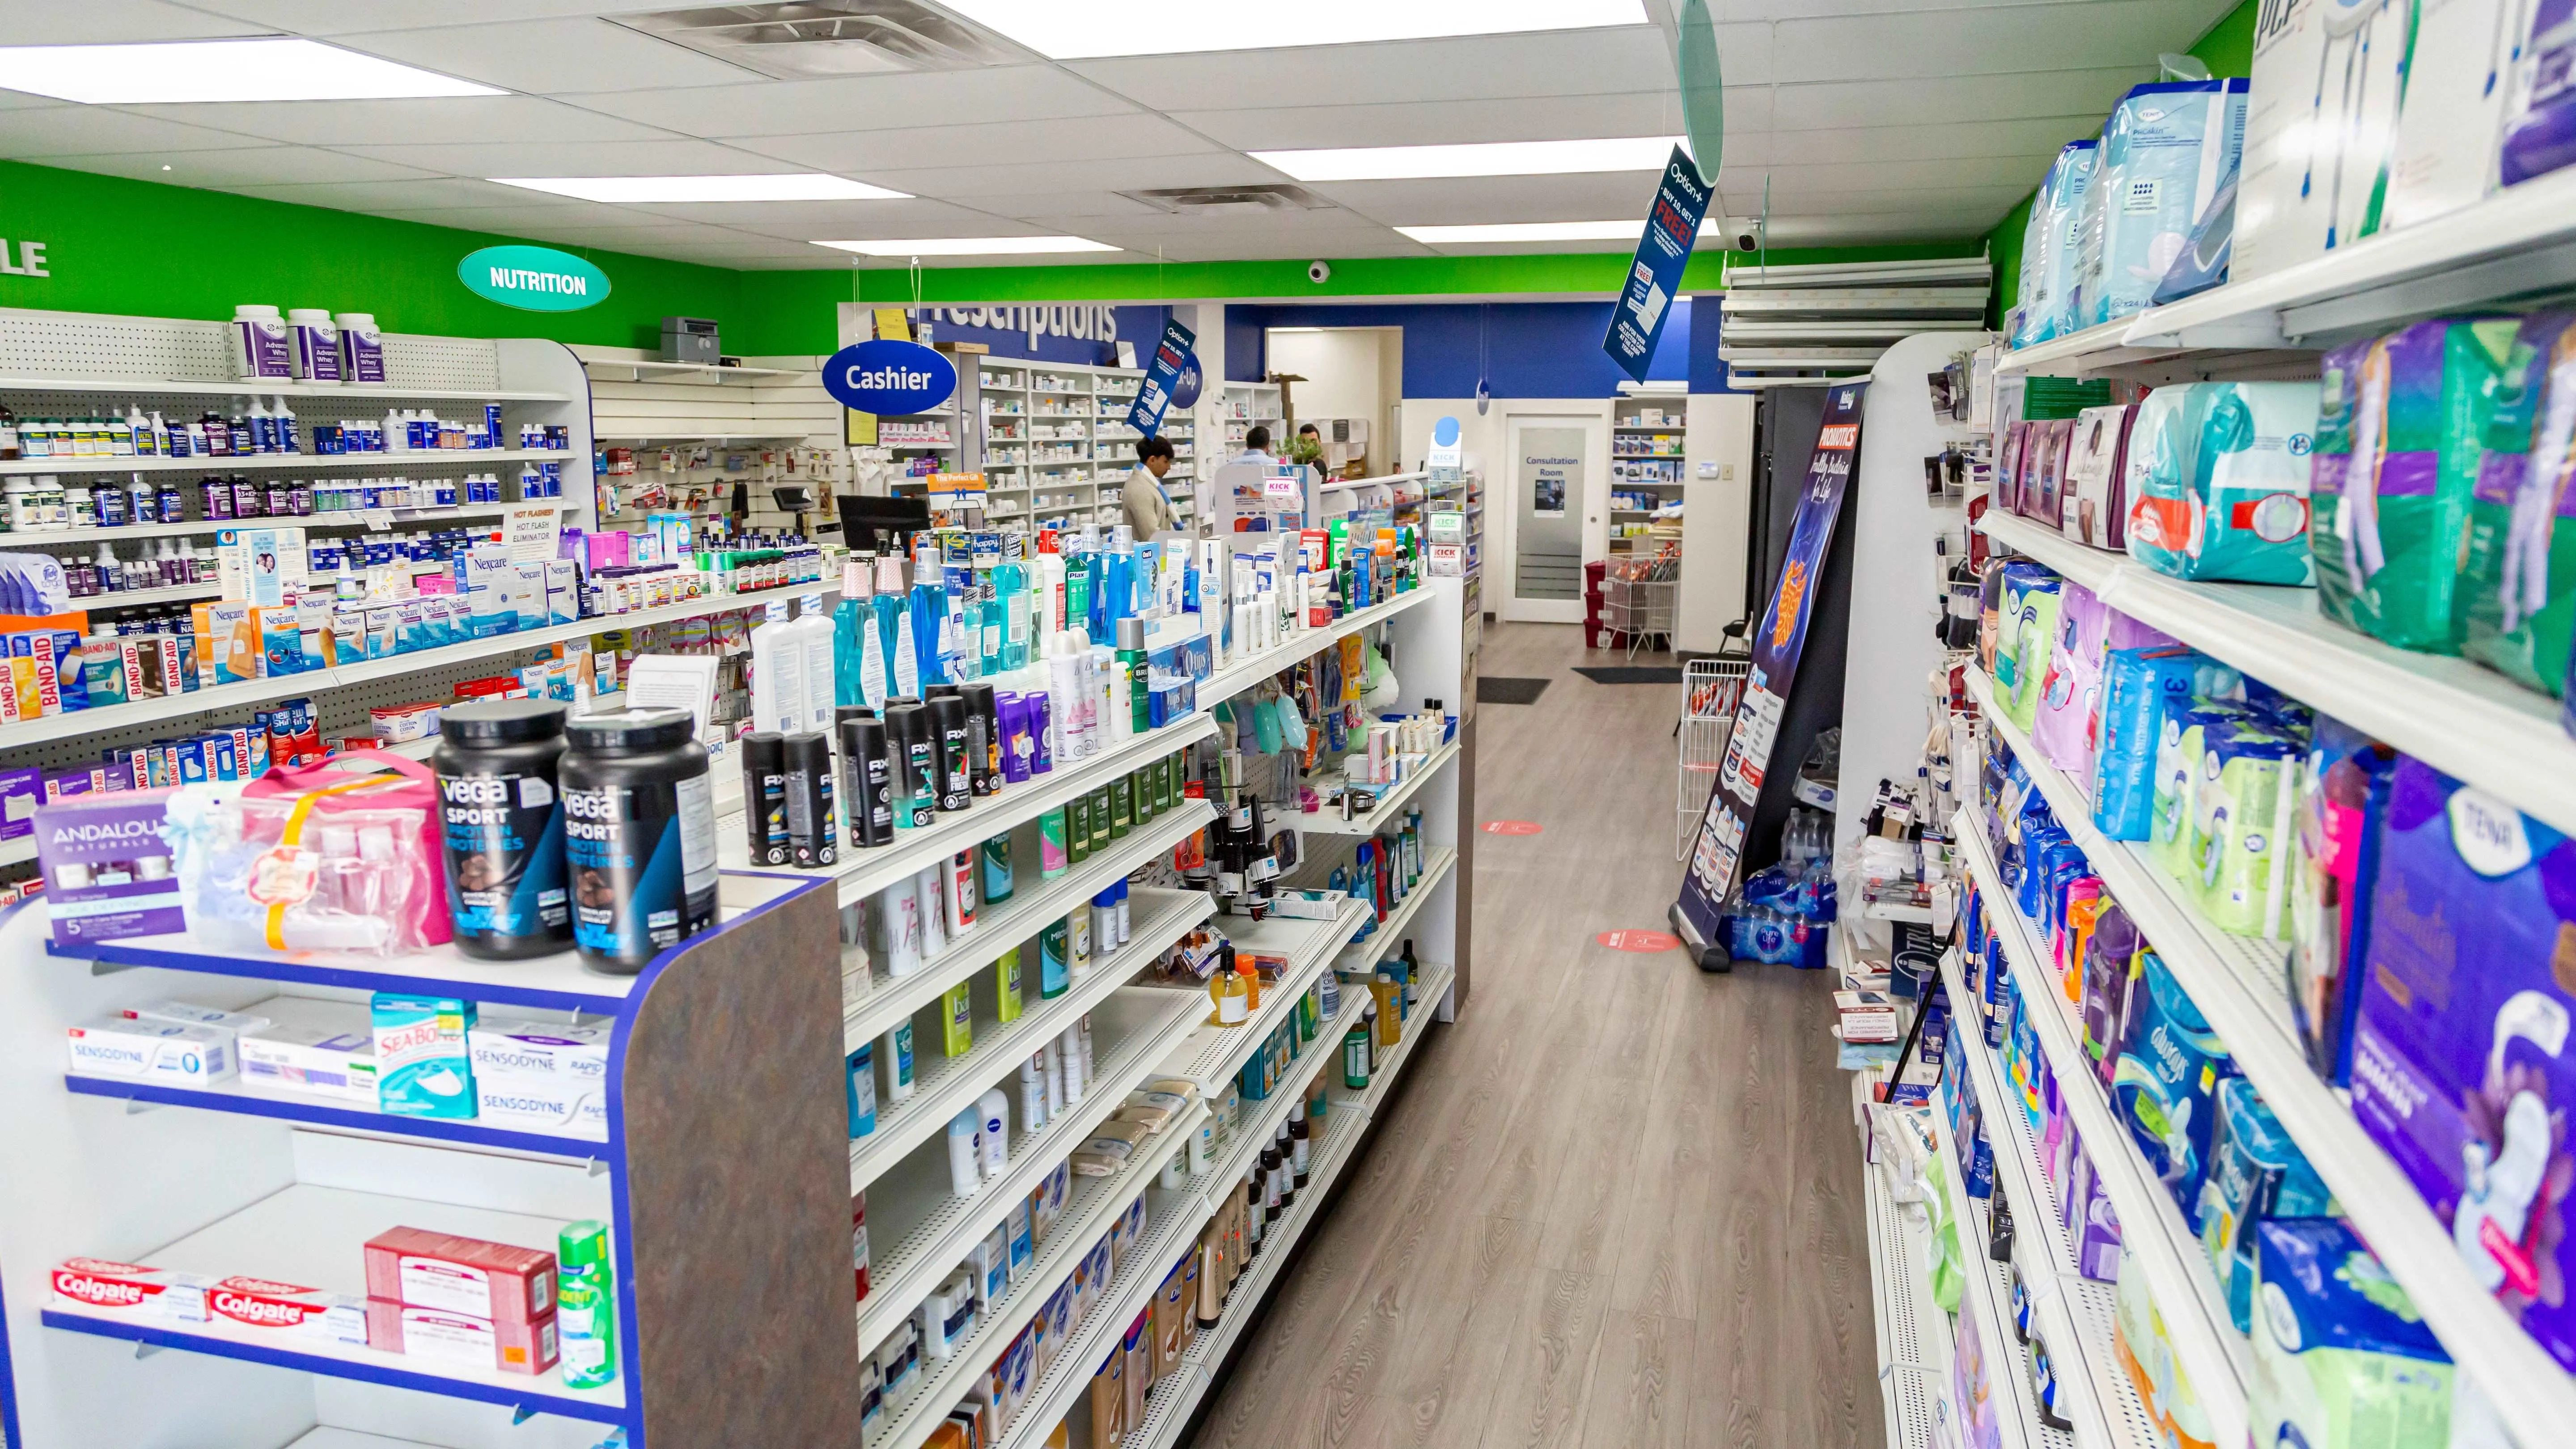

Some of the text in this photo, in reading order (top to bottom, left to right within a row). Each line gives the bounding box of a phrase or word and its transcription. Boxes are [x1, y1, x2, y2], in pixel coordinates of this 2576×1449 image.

[1663, 187, 1696, 227] BUY 10, GET 1
[1656, 198, 1692, 246] FREE!
[490, 267, 587, 296] NUTRITION
[1637, 269, 1651, 283] FREE!
[1168, 327, 1189, 347] Option+
[1618, 324, 1646, 353] COLLECTOR CARD
[1635, 331, 1646, 345] YOUR
[272, 349, 287, 357] Whey
[1631, 343, 1640, 356] CASH
[846, 365, 932, 390] Cashier
[1526, 457, 1578, 465] Consultation
[1540, 468, 1563, 476] Room
[513, 532, 550, 542] ELIMINATOR
[973, 538, 999, 548] happy
[474, 558, 507, 572] Nexcare
[551, 566, 571, 575] Nexcare
[43, 568, 59, 580] Tide
[519, 571, 541, 580] Nexcare
[303, 600, 326, 609] Nexcare
[424, 605, 445, 614] Nexcare
[449, 600, 468, 609] Nexcare
[216, 610, 244, 621] Nexcare
[266, 615, 295, 625] Nexcare
[372, 611, 390, 620] Nexcare
[396, 608, 419, 618] Nexcare
[340, 617, 361, 626] Nexcare
[474, 626, 479, 636] 6
[82, 642, 117, 655] BAND-AID
[568, 642, 587, 653] Nexcare
[165, 640, 180, 687] BAND-AID
[547, 661, 564, 670] Nexcare
[1186, 650, 1206, 674] Q-tips
[34, 638, 59, 707] BAND-AID
[125, 648, 142, 695] BAND-AID
[0, 665, 17, 716] BAND-AID
[235, 731, 249, 776] BAND-AID
[208, 743, 217, 779] BAND-AID
[167, 750, 180, 787] BAND-AID
[764, 775, 784, 786] AX
[441, 780, 508, 804] vega
[560, 794, 620, 819] vega
[447, 808, 509, 825] SPORT
[52, 818, 159, 844] ANDALOU
[566, 821, 620, 839] SPORT
[1760, 928, 1779, 937] Pure
[1322, 970, 1334, 979] live
[75, 1044, 143, 1063] SENSODYNE
[475, 1050, 557, 1071] SENSODYNE
[483, 1096, 565, 1114] SENSODYNE
[56, 1272, 143, 1302] Colgate
[215, 1292, 303, 1325] Colgate
